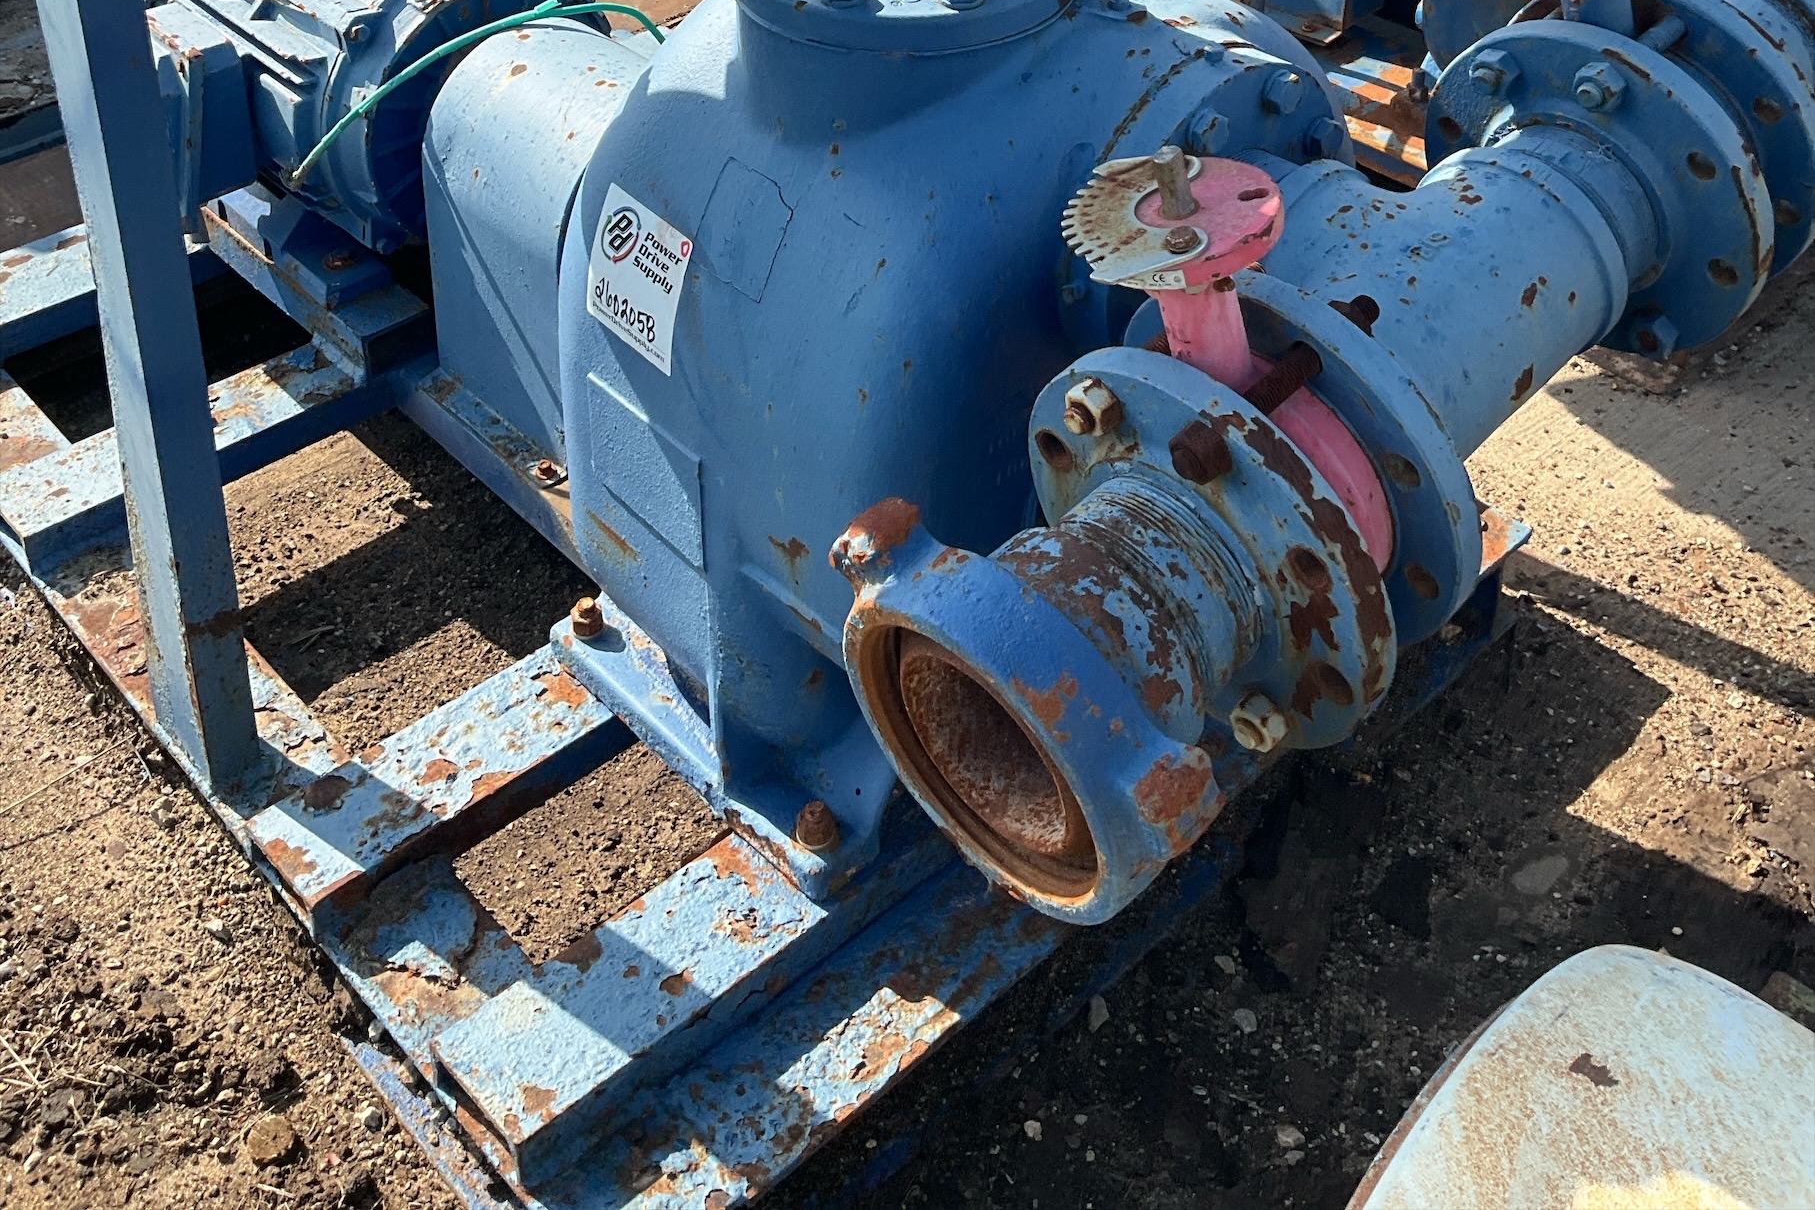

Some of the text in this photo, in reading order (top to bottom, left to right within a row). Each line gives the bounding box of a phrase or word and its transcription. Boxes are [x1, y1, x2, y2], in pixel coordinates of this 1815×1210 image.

[638, 243, 670, 274] Drive
[644, 231, 683, 266] Power
[632, 255, 673, 295] Supply
